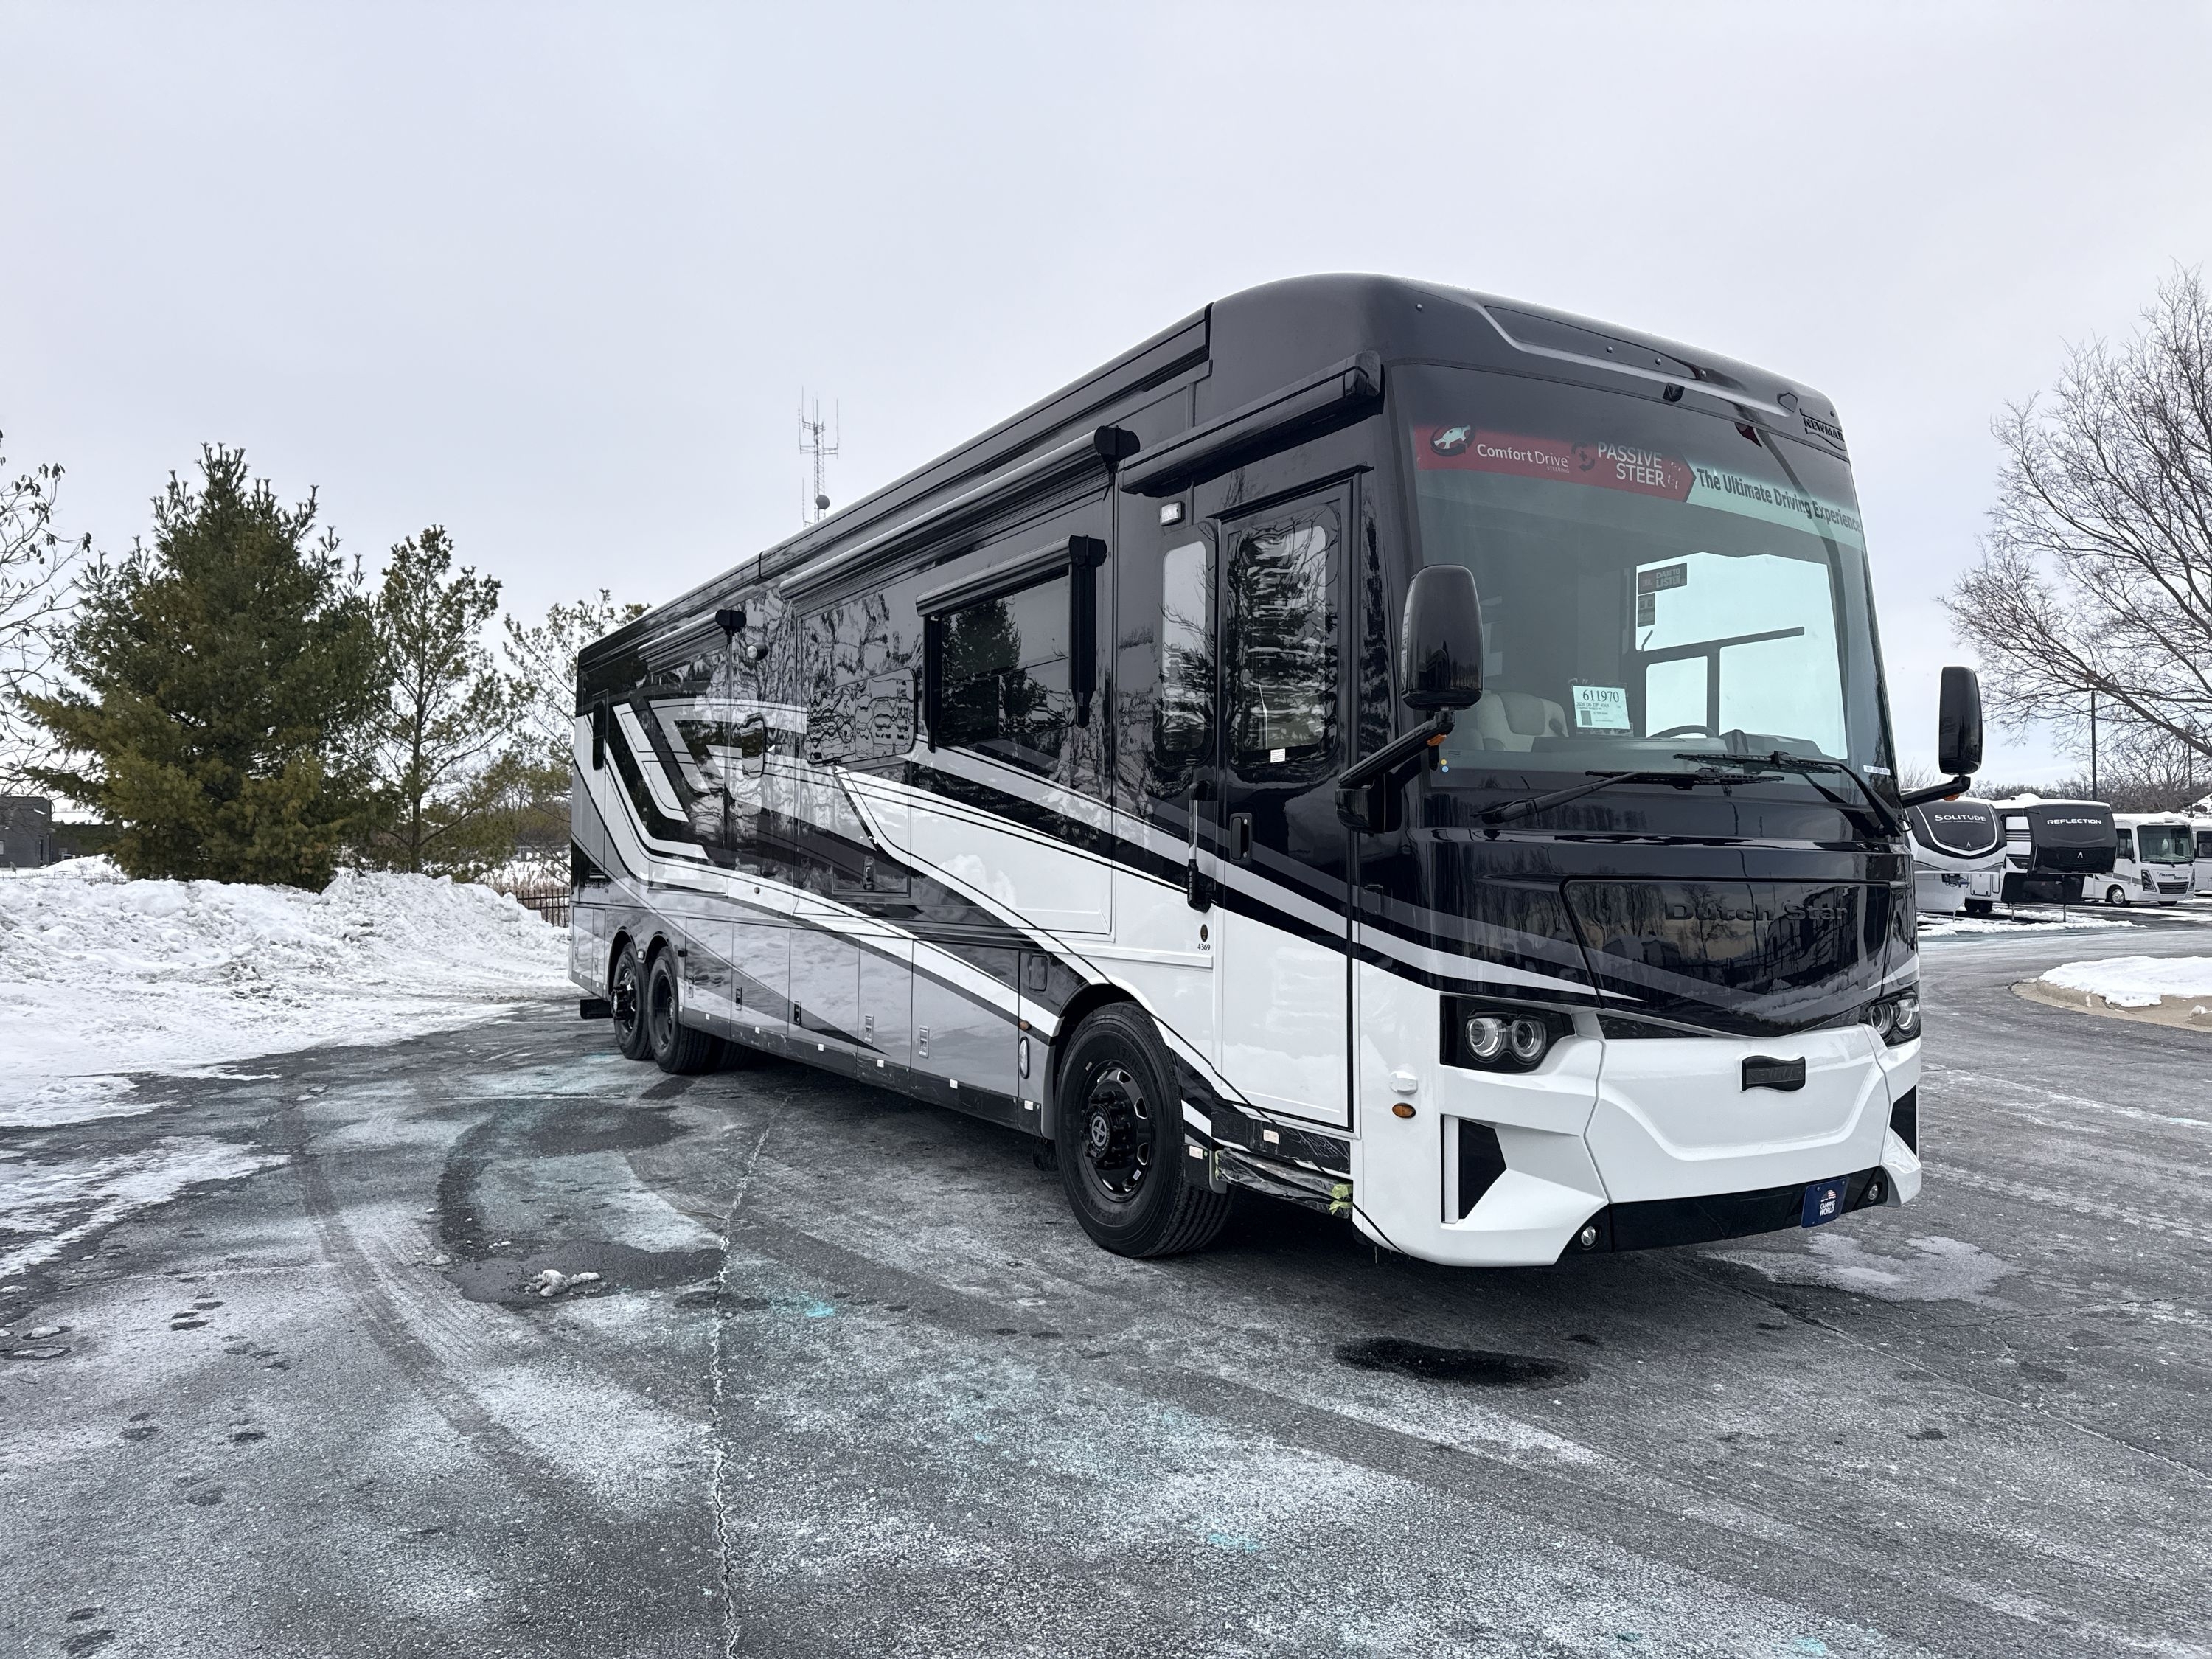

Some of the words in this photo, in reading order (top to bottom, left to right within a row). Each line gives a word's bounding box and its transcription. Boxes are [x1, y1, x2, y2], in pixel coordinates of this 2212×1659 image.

[1477, 443, 1534, 463] Comfort
[1534, 451, 1568, 467] Drive
[1597, 441, 1663, 469] PASSIVE
[1615, 462, 1666, 488] STEER
[1697, 467, 1721, 491] The
[1722, 473, 1773, 504] Ultimate
[1773, 487, 1813, 520] Driving
[1814, 500, 1862, 534] Experience
[1582, 689, 1620, 703] 611970
[1934, 814, 1987, 822] SOLITUDE
[1665, 902, 1774, 921] Dutch
[1784, 901, 1848, 921] Star
[1197, 943, 1211, 951] 4369
[1819, 1206, 1835, 1217] WORLD
